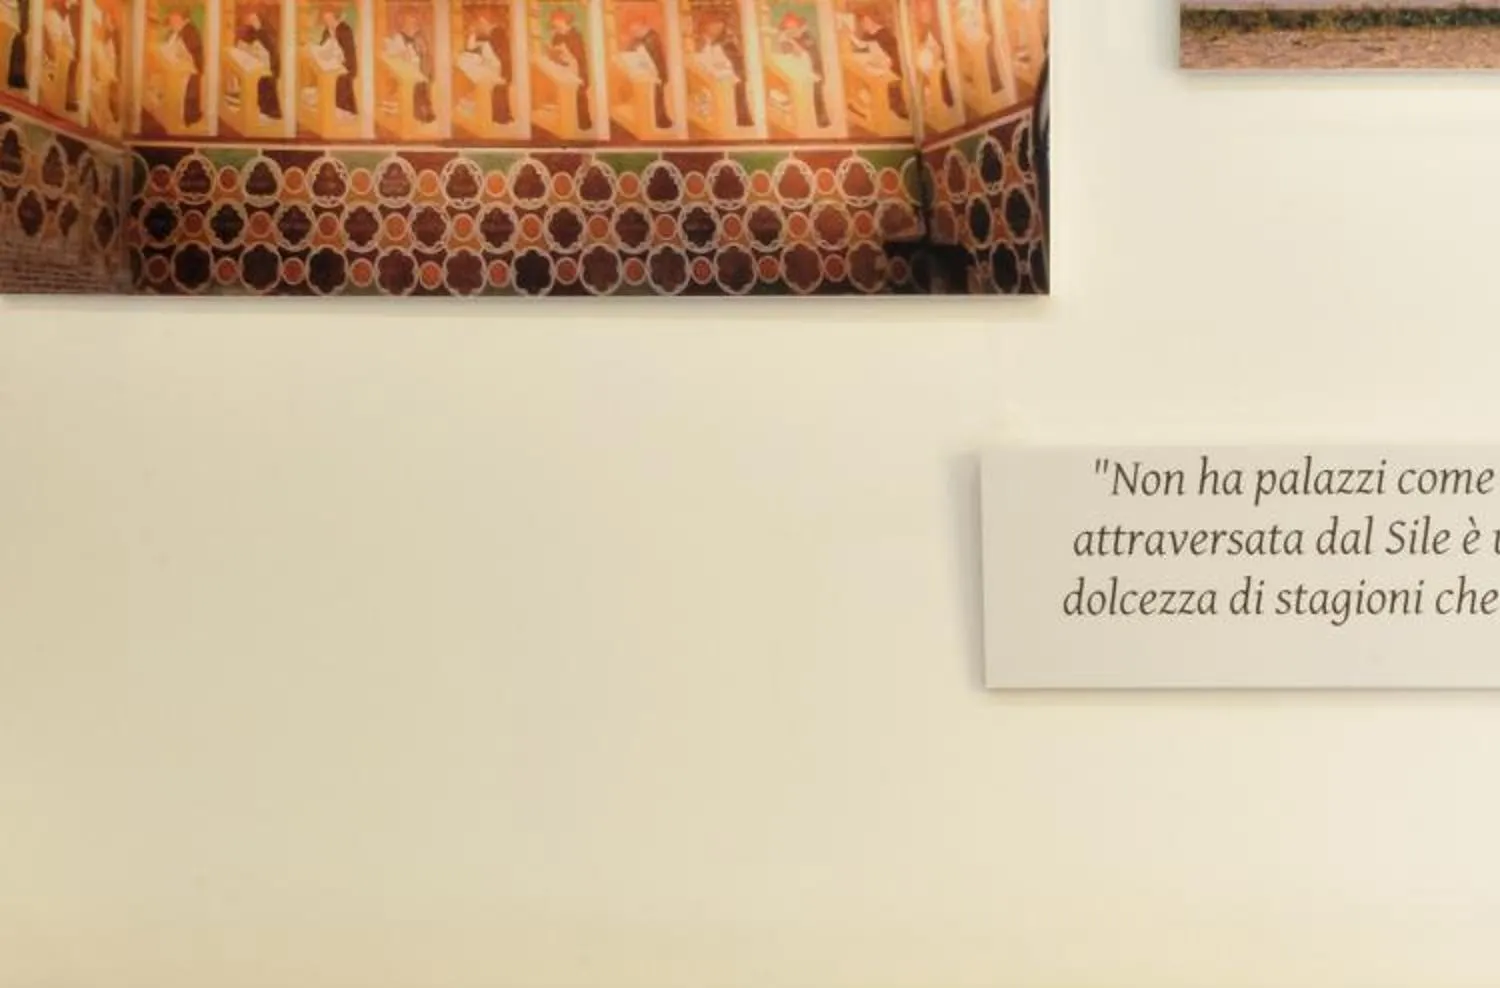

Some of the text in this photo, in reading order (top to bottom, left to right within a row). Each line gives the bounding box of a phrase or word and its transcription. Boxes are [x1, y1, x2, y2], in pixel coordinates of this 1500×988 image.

[1095, 457, 1185, 497] "Non
[1197, 454, 1245, 496] ha
[1253, 454, 1388, 508] palazzi
[1396, 467, 1496, 496] come
[1072, 524, 1305, 558] attraversata
[1315, 514, 1374, 556] dal
[1384, 514, 1452, 556] Sile
[1461, 515, 1482, 556] è
[1062, 575, 1219, 617] dolcezza
[1228, 575, 1265, 616] di
[1274, 578, 1425, 628] stagioni
[1434, 574, 1500, 616] che
